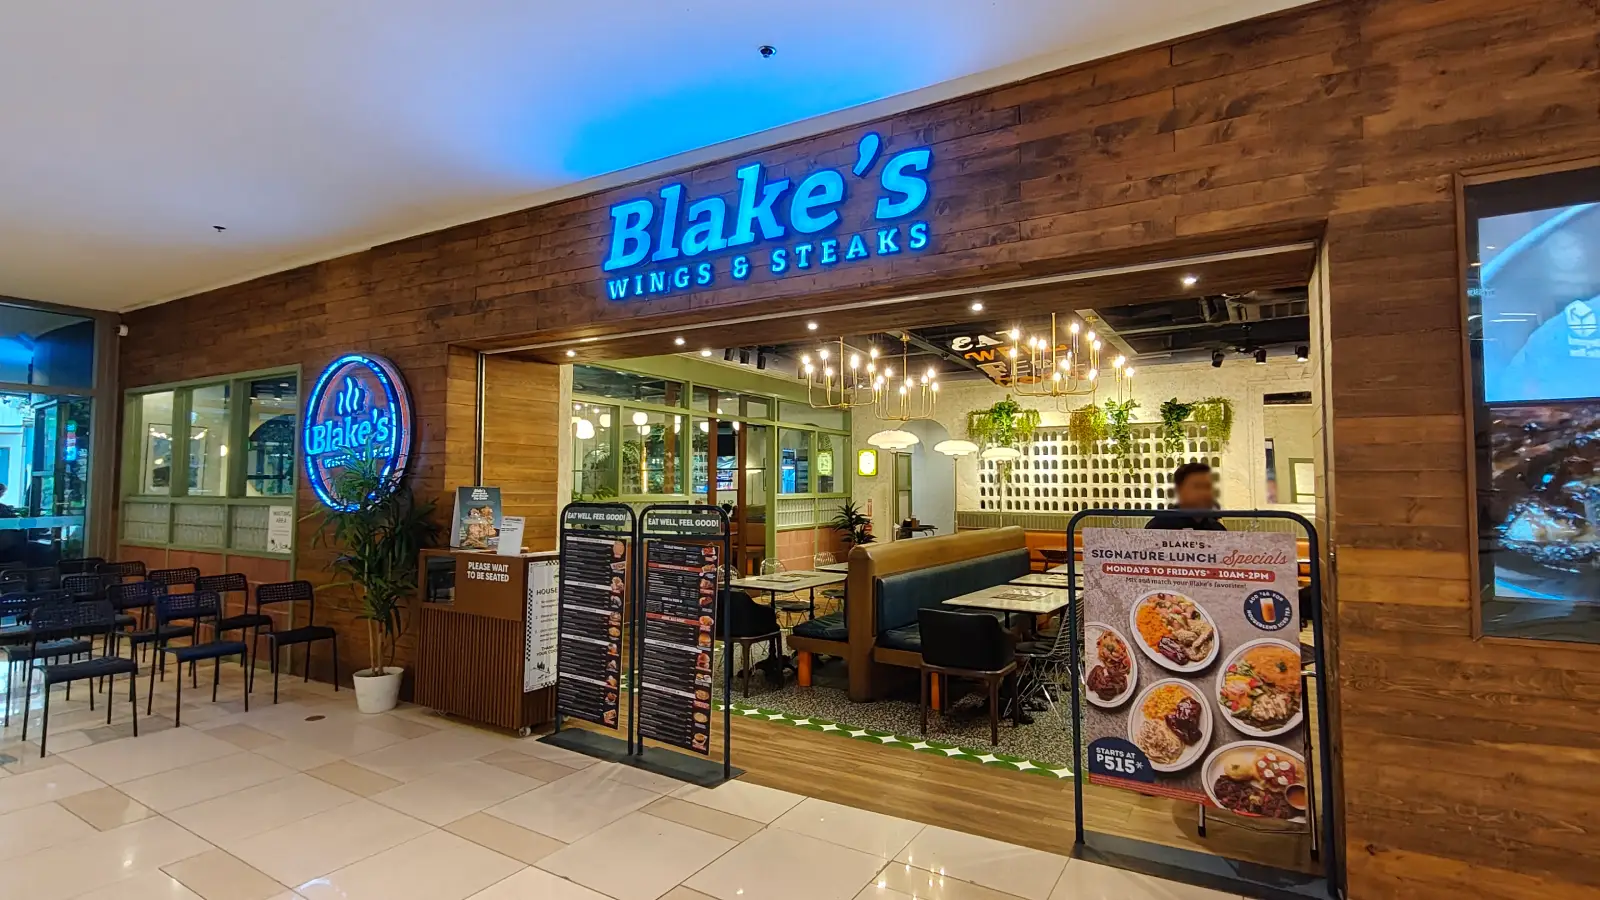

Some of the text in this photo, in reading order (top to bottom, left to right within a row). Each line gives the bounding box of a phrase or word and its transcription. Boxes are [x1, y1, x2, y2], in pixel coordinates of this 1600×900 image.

[604, 132, 932, 271] Blake's
[607, 222, 930, 300] WINGS & STEAKS
[311, 408, 389, 454] Blake's
[648, 518, 719, 528] EAT WELL, FEEL GOOD!
[1162, 541, 1205, 549] BLAKE'S
[1091, 549, 1288, 567] SIGNATURE LUNCH Specials
[468, 561, 509, 573] PLEASE WAIT
[1106, 565, 1150, 574] MONDAYS
[1151, 566, 1164, 575] TO
[1218, 570, 1269, 580] 10AM-2PM
[467, 571, 509, 582] TO BE SEATED
[536, 587, 558, 595] HOUSE
[1095, 747, 1124, 758] STARTS
